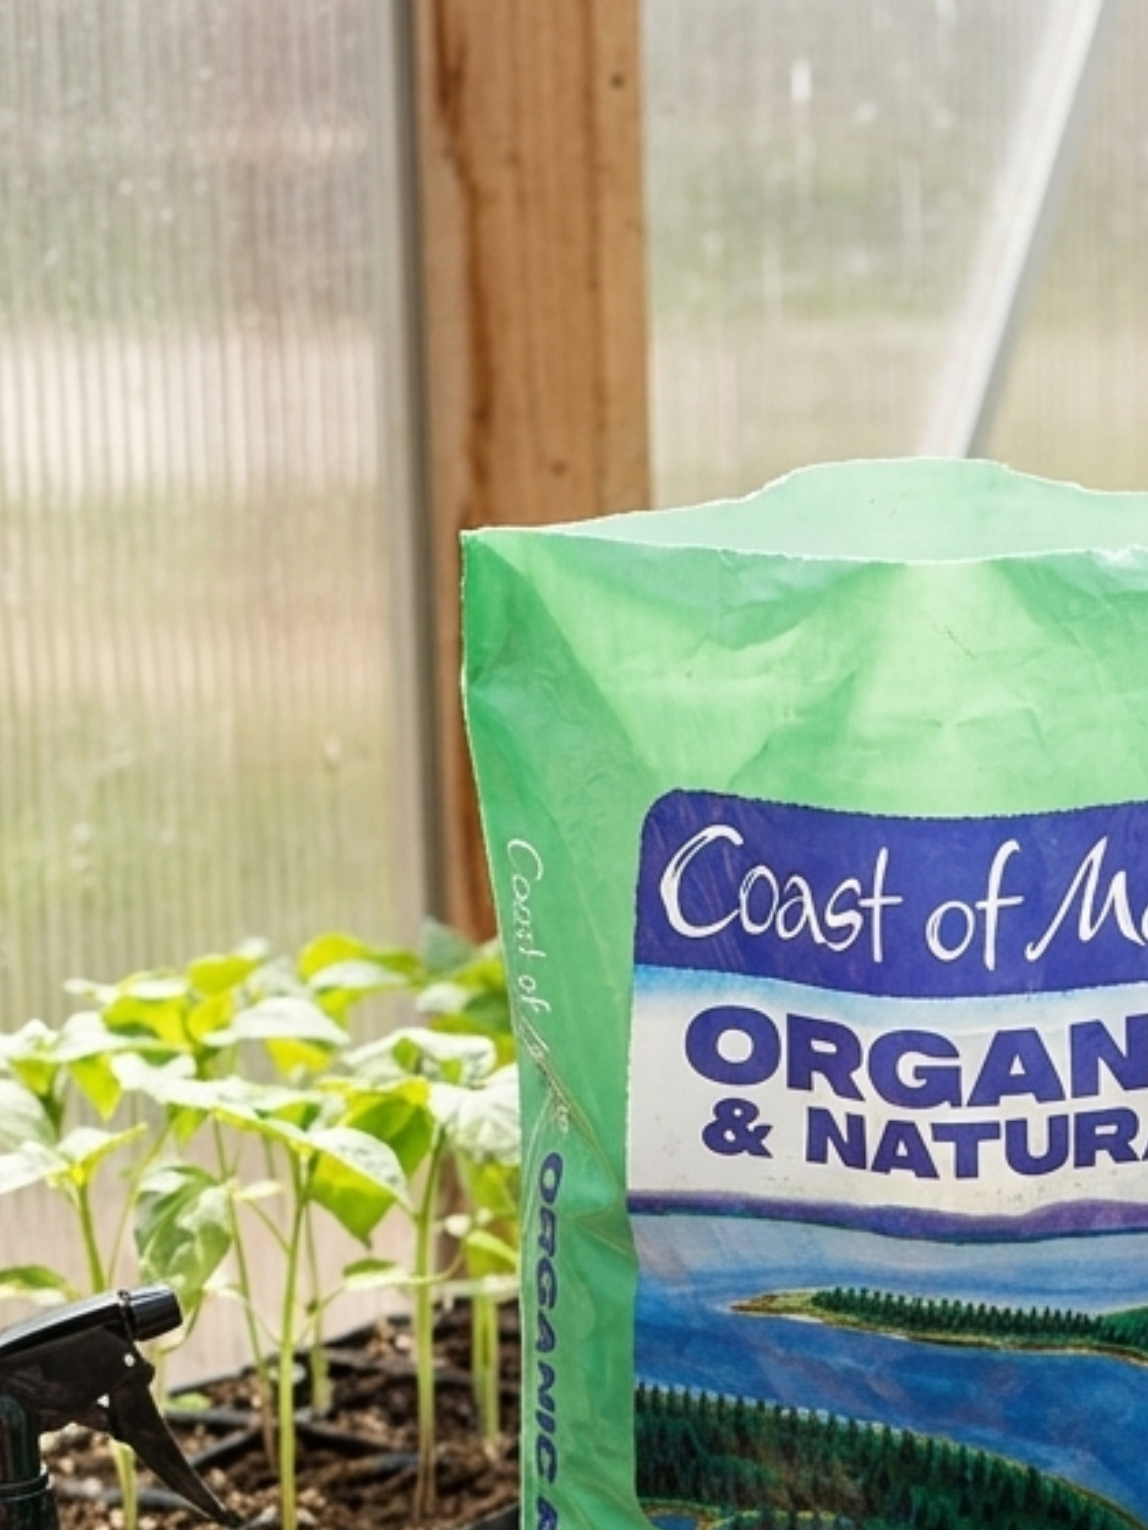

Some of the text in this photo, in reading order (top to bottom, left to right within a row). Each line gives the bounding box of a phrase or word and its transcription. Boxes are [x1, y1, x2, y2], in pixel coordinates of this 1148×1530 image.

[660, 824, 902, 962] Coast
[925, 839, 1023, 970] of
[701, 1097, 772, 1159] &
